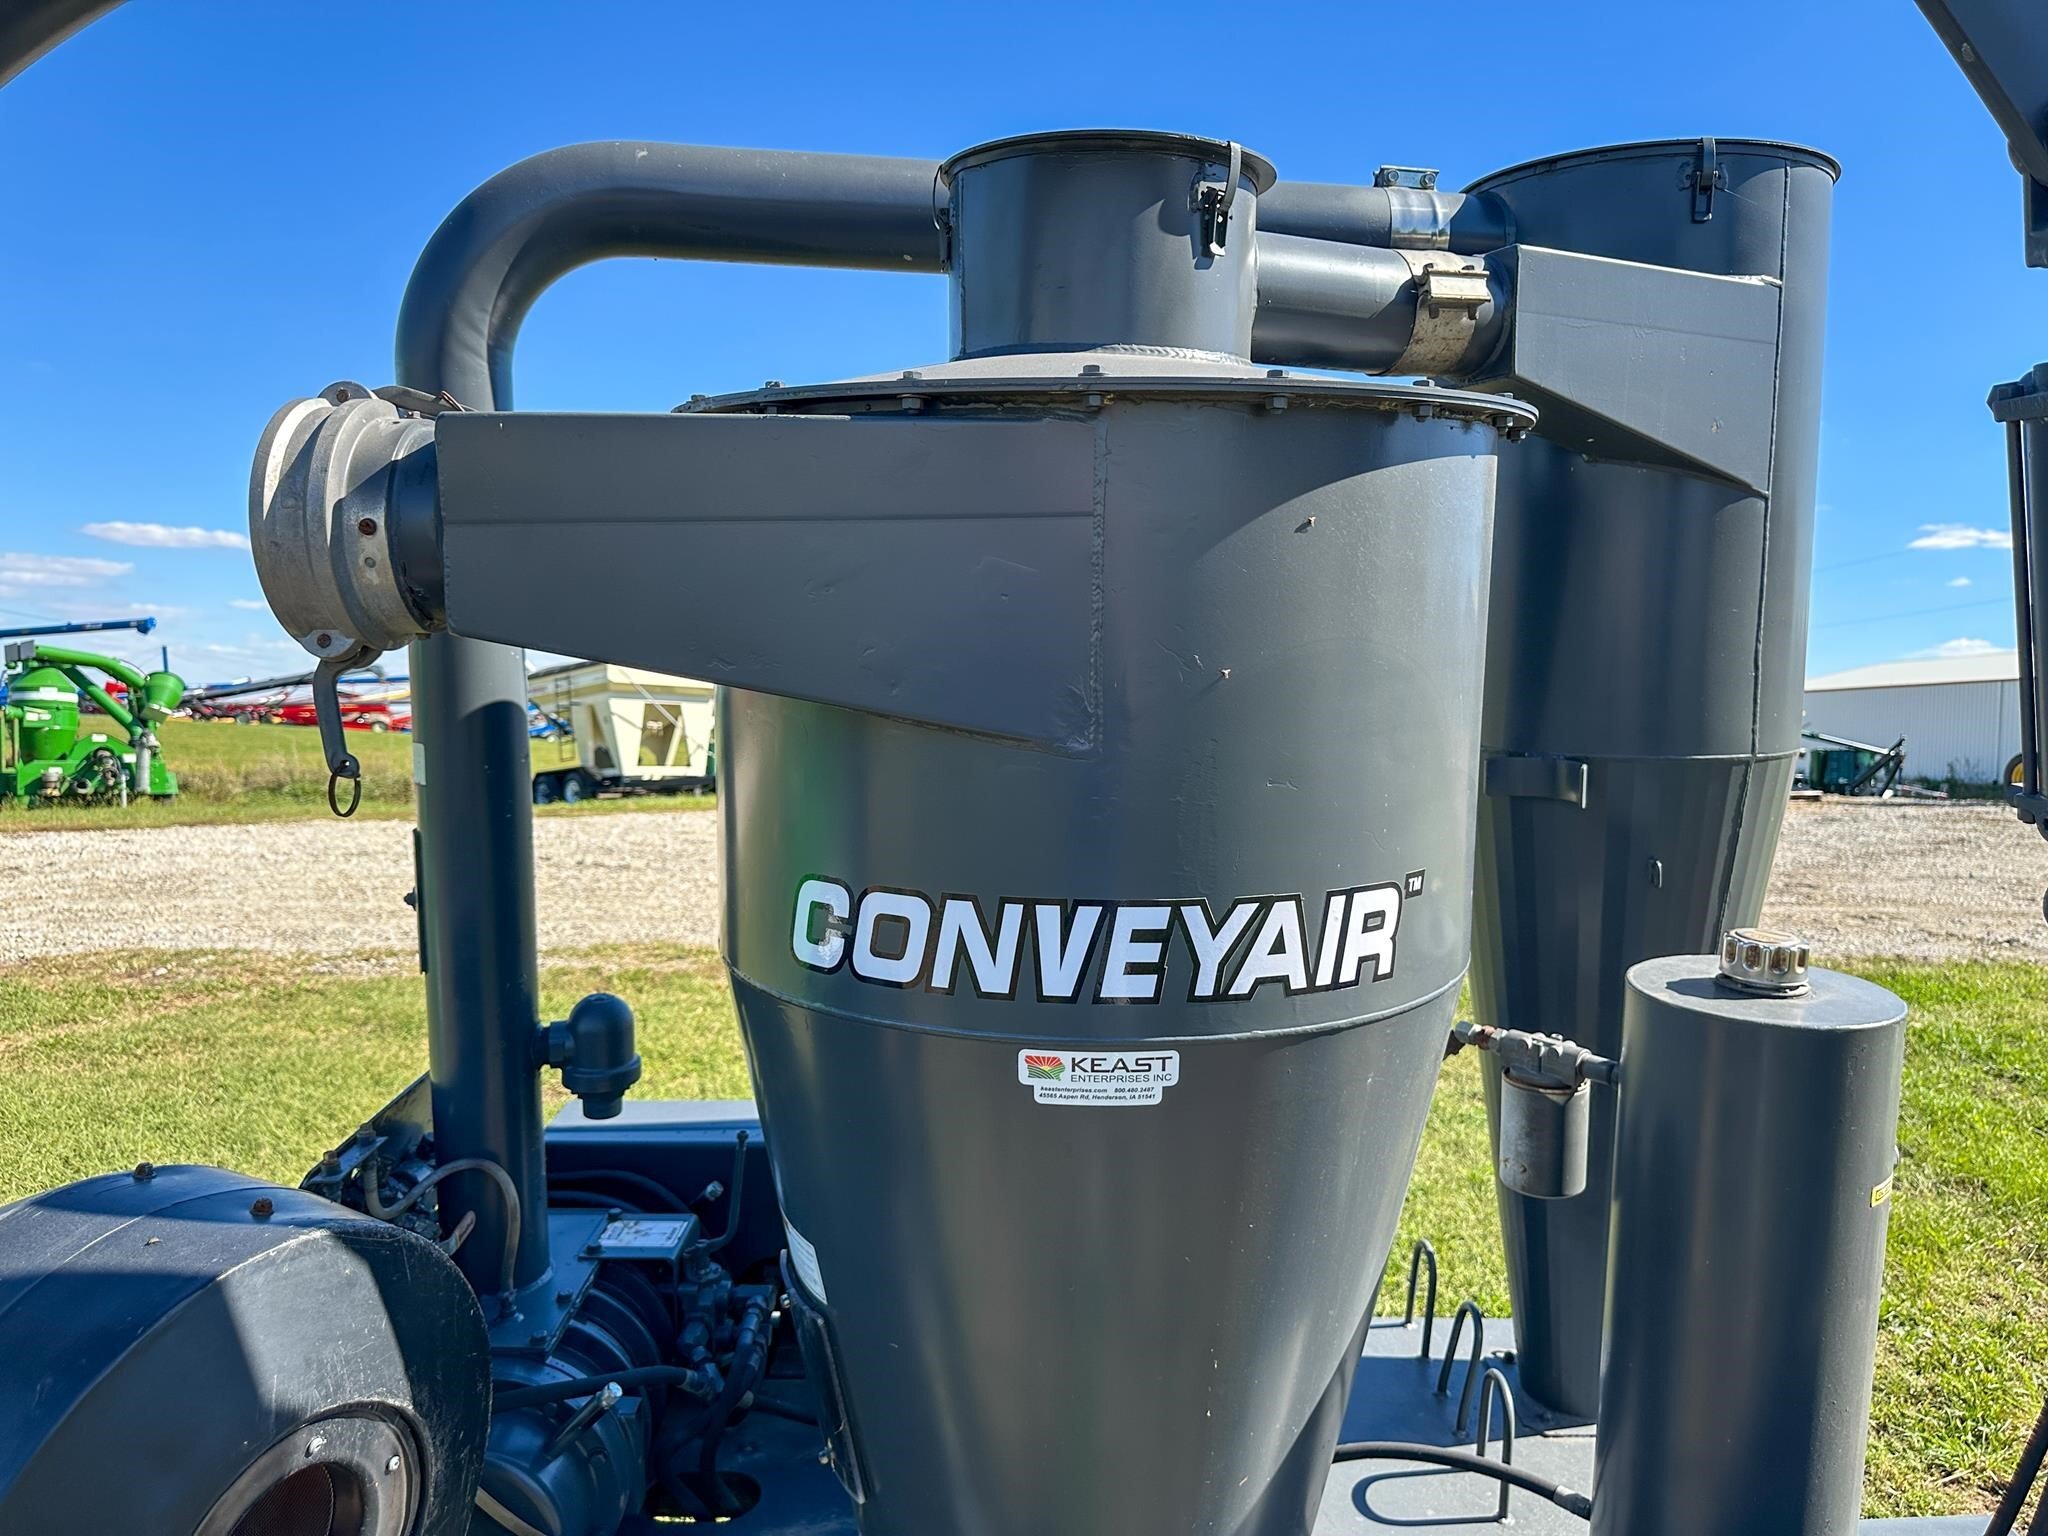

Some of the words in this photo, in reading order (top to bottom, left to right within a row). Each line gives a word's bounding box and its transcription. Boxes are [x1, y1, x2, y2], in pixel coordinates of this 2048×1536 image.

[1407, 875, 1423, 893] TM
[791, 873, 1403, 1006] CONVEYAIR
[1071, 1056, 1173, 1073] KEAST
[1070, 1074, 1151, 1083] ENTERPRISES
[1153, 1073, 1173, 1082] INC
